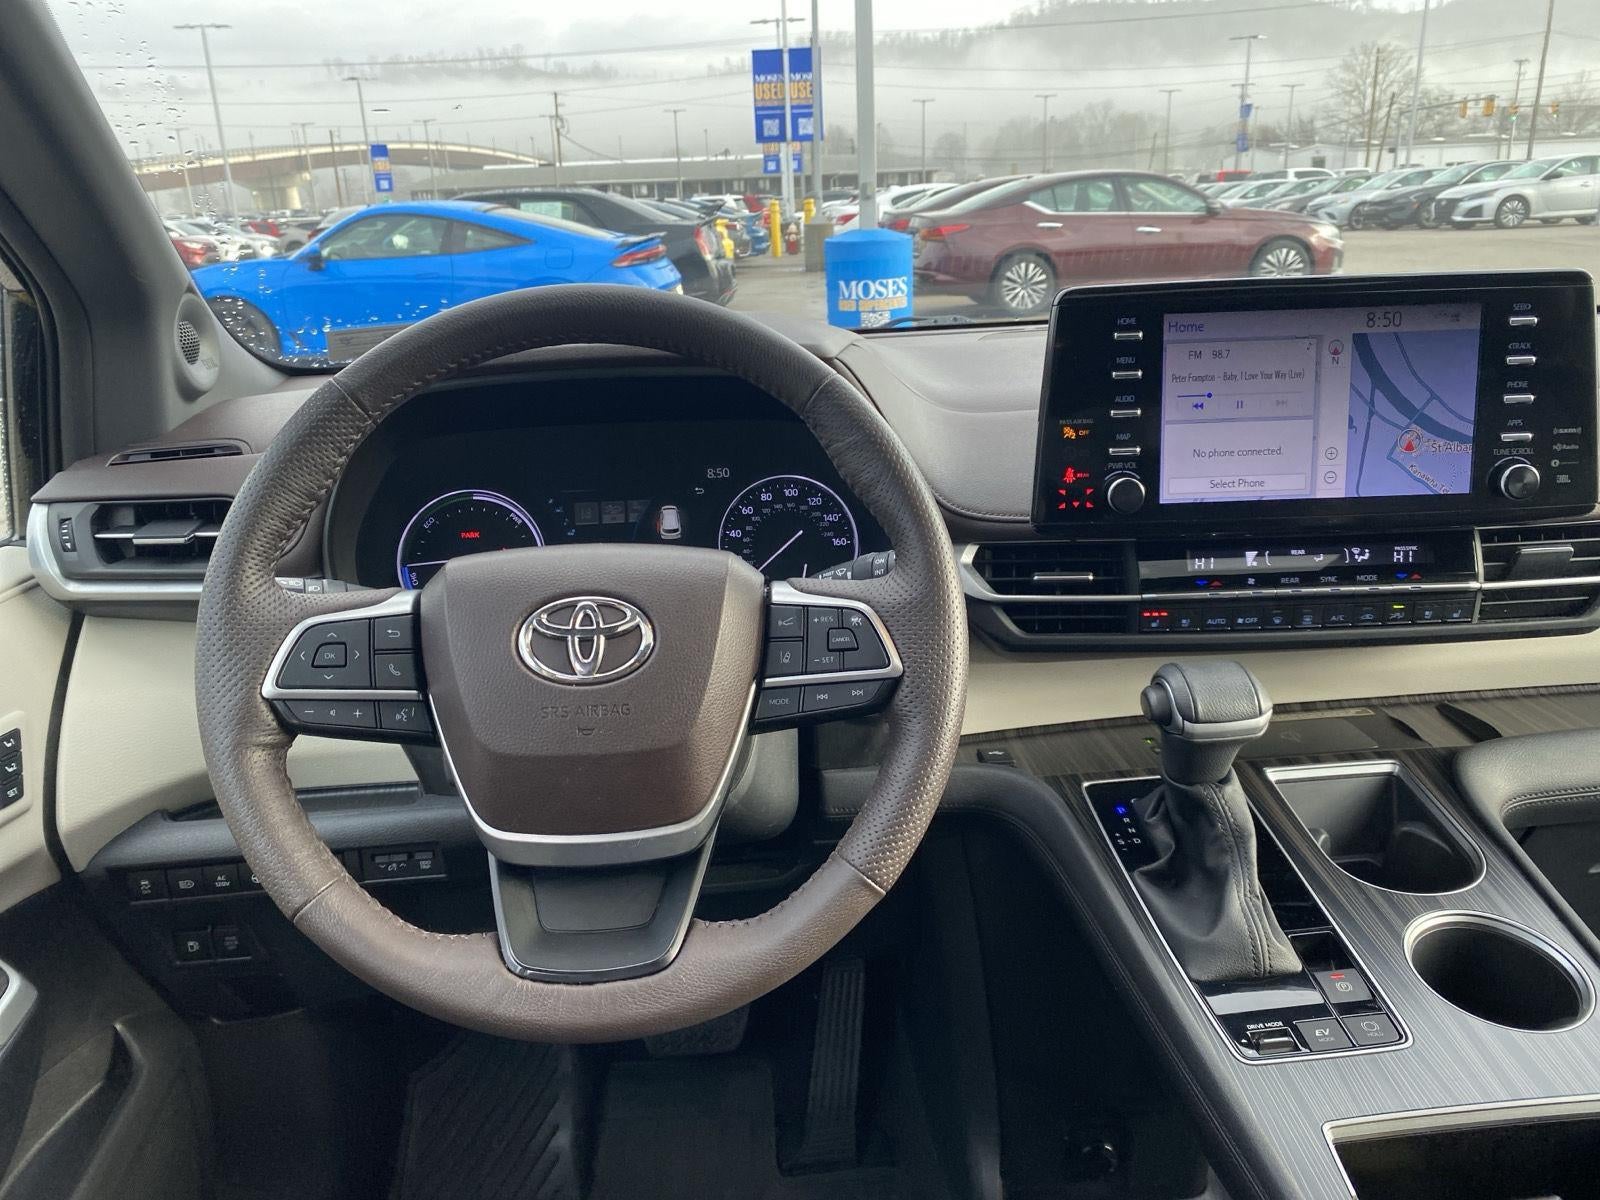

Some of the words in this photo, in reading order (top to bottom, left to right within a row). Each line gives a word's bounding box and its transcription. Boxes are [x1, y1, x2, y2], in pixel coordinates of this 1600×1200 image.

[755, 82, 785, 99] USED
[791, 81, 812, 98] USE
[838, 276, 908, 299] MOSES
[1117, 317, 1137, 325] HOME
[1366, 311, 1402, 328] 8:50
[1168, 321, 1205, 333] Home
[1188, 350, 1203, 360] FM
[1211, 349, 1231, 359] 98.7
[1116, 356, 1136, 364] MENU
[1171, 373, 1187, 383] Peter
[1245, 370, 1258, 381] Love
[1260, 370, 1273, 380] Your
[1274, 369, 1287, 381] Way
[1288, 368, 1305, 380] (Live)
[1115, 395, 1135, 403] AUDIO
[1116, 433, 1131, 441] MAP
[1193, 448, 1207, 459] No
[1208, 448, 1235, 460] phone
[1237, 446, 1284, 457] connected.
[707, 467, 730, 479] 8:50
[1210, 479, 1236, 489] Select
[1238, 478, 1265, 488] Phone
[760, 493, 773, 501] 80
[783, 488, 799, 497] 100
[807, 497, 822, 506] 120
[741, 506, 754, 515] 60
[822, 513, 839, 522] 140
[423, 516, 435, 529] ECO
[460, 531, 480, 539] PARK
[729, 529, 742, 538] 40
[831, 538, 847, 546] 160
[324, 652, 336, 660] OK
[540, 706, 570, 719] SRS
[575, 703, 632, 718] AIRBAG
[6, 787, 18, 798] SET
[1246, 1022, 1265, 1030] DRIVE
[1265, 1021, 1284, 1029] MODE
[1315, 1028, 1330, 1037] EV
